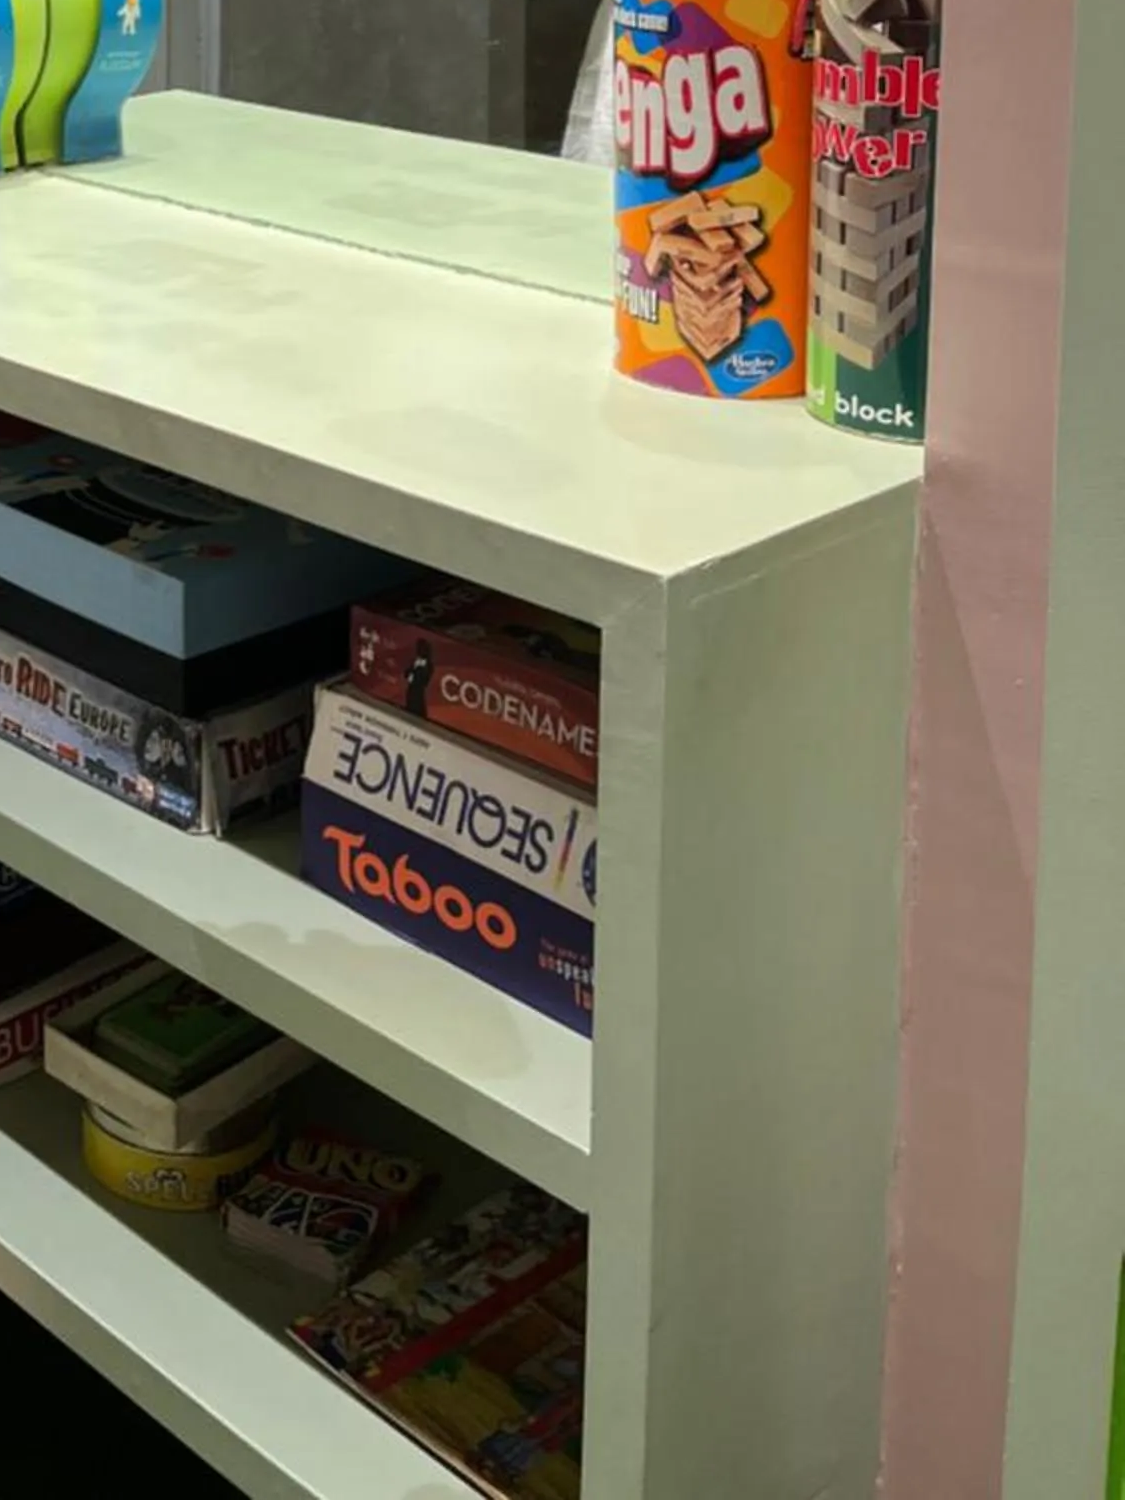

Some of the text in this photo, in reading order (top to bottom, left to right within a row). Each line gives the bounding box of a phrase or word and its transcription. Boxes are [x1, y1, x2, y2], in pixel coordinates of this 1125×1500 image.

[614, 45, 769, 177] enga
[813, 47, 941, 118] mble
[834, 389, 915, 428] block
[15, 657, 67, 717] RIDE
[68, 693, 132, 743] EUROPE
[439, 672, 598, 758] CODENAME
[333, 731, 555, 873] SEQUENCE
[321, 824, 518, 951] Taboo
[284, 1136, 423, 1193] UNO
